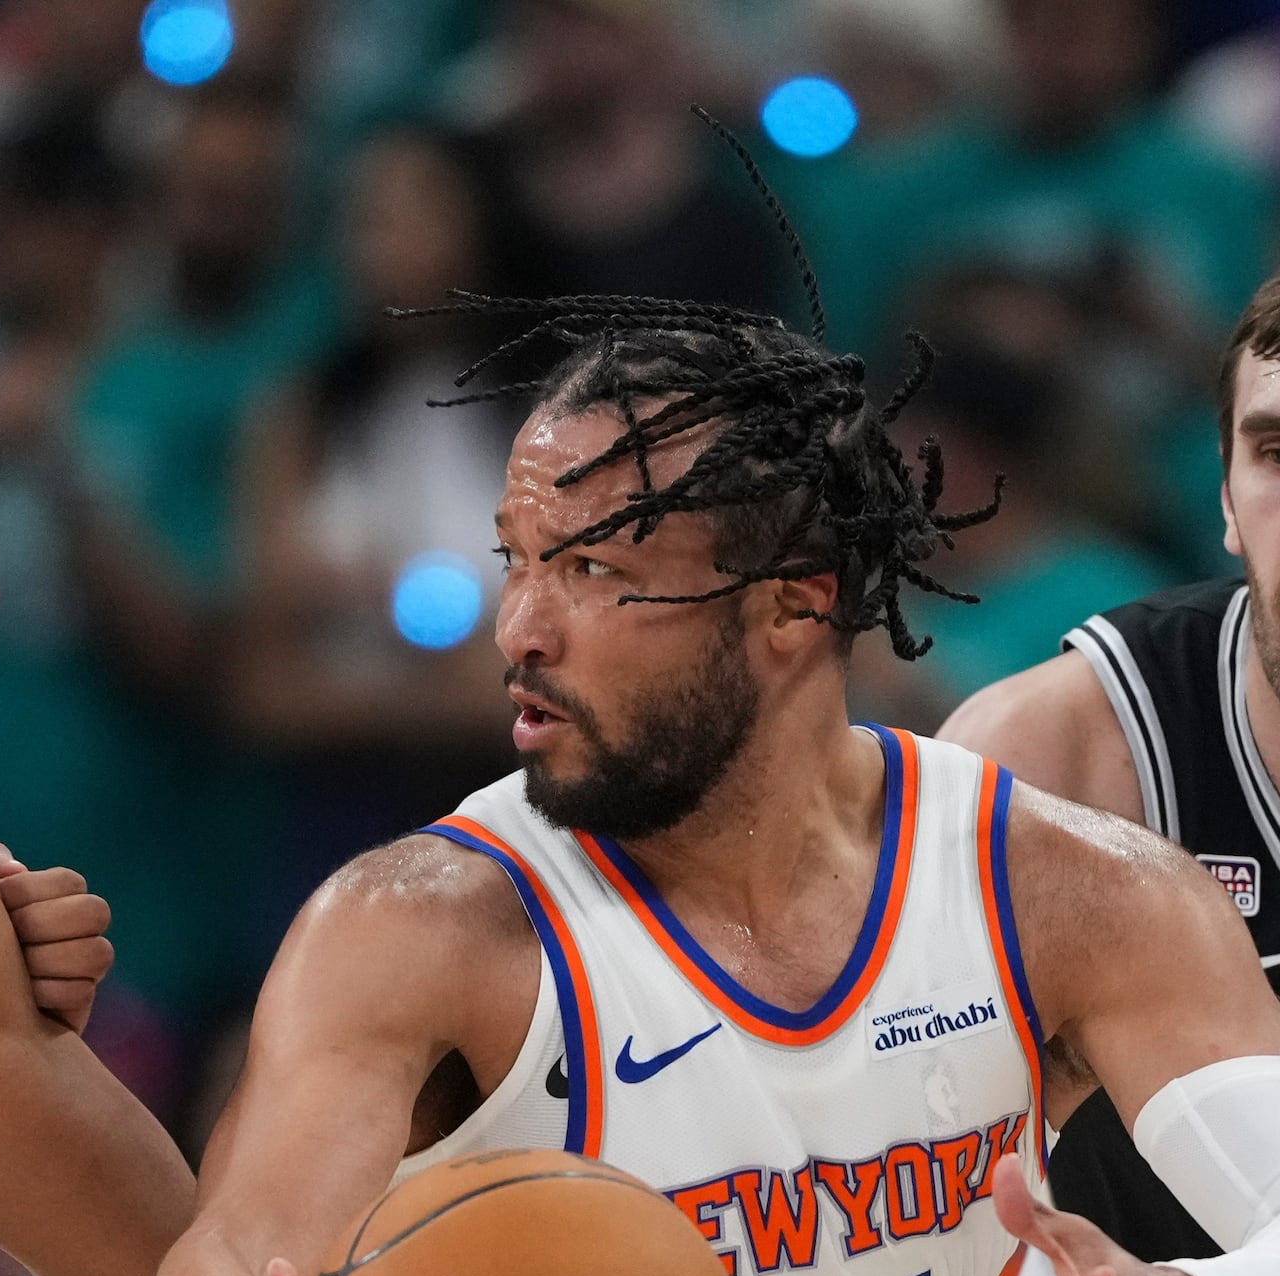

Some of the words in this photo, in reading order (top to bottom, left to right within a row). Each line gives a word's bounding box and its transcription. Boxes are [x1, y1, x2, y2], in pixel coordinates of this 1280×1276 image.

[872, 1003, 934, 1026] experience
[875, 1025, 922, 1051] abu
[925, 997, 998, 1039] dhabi
